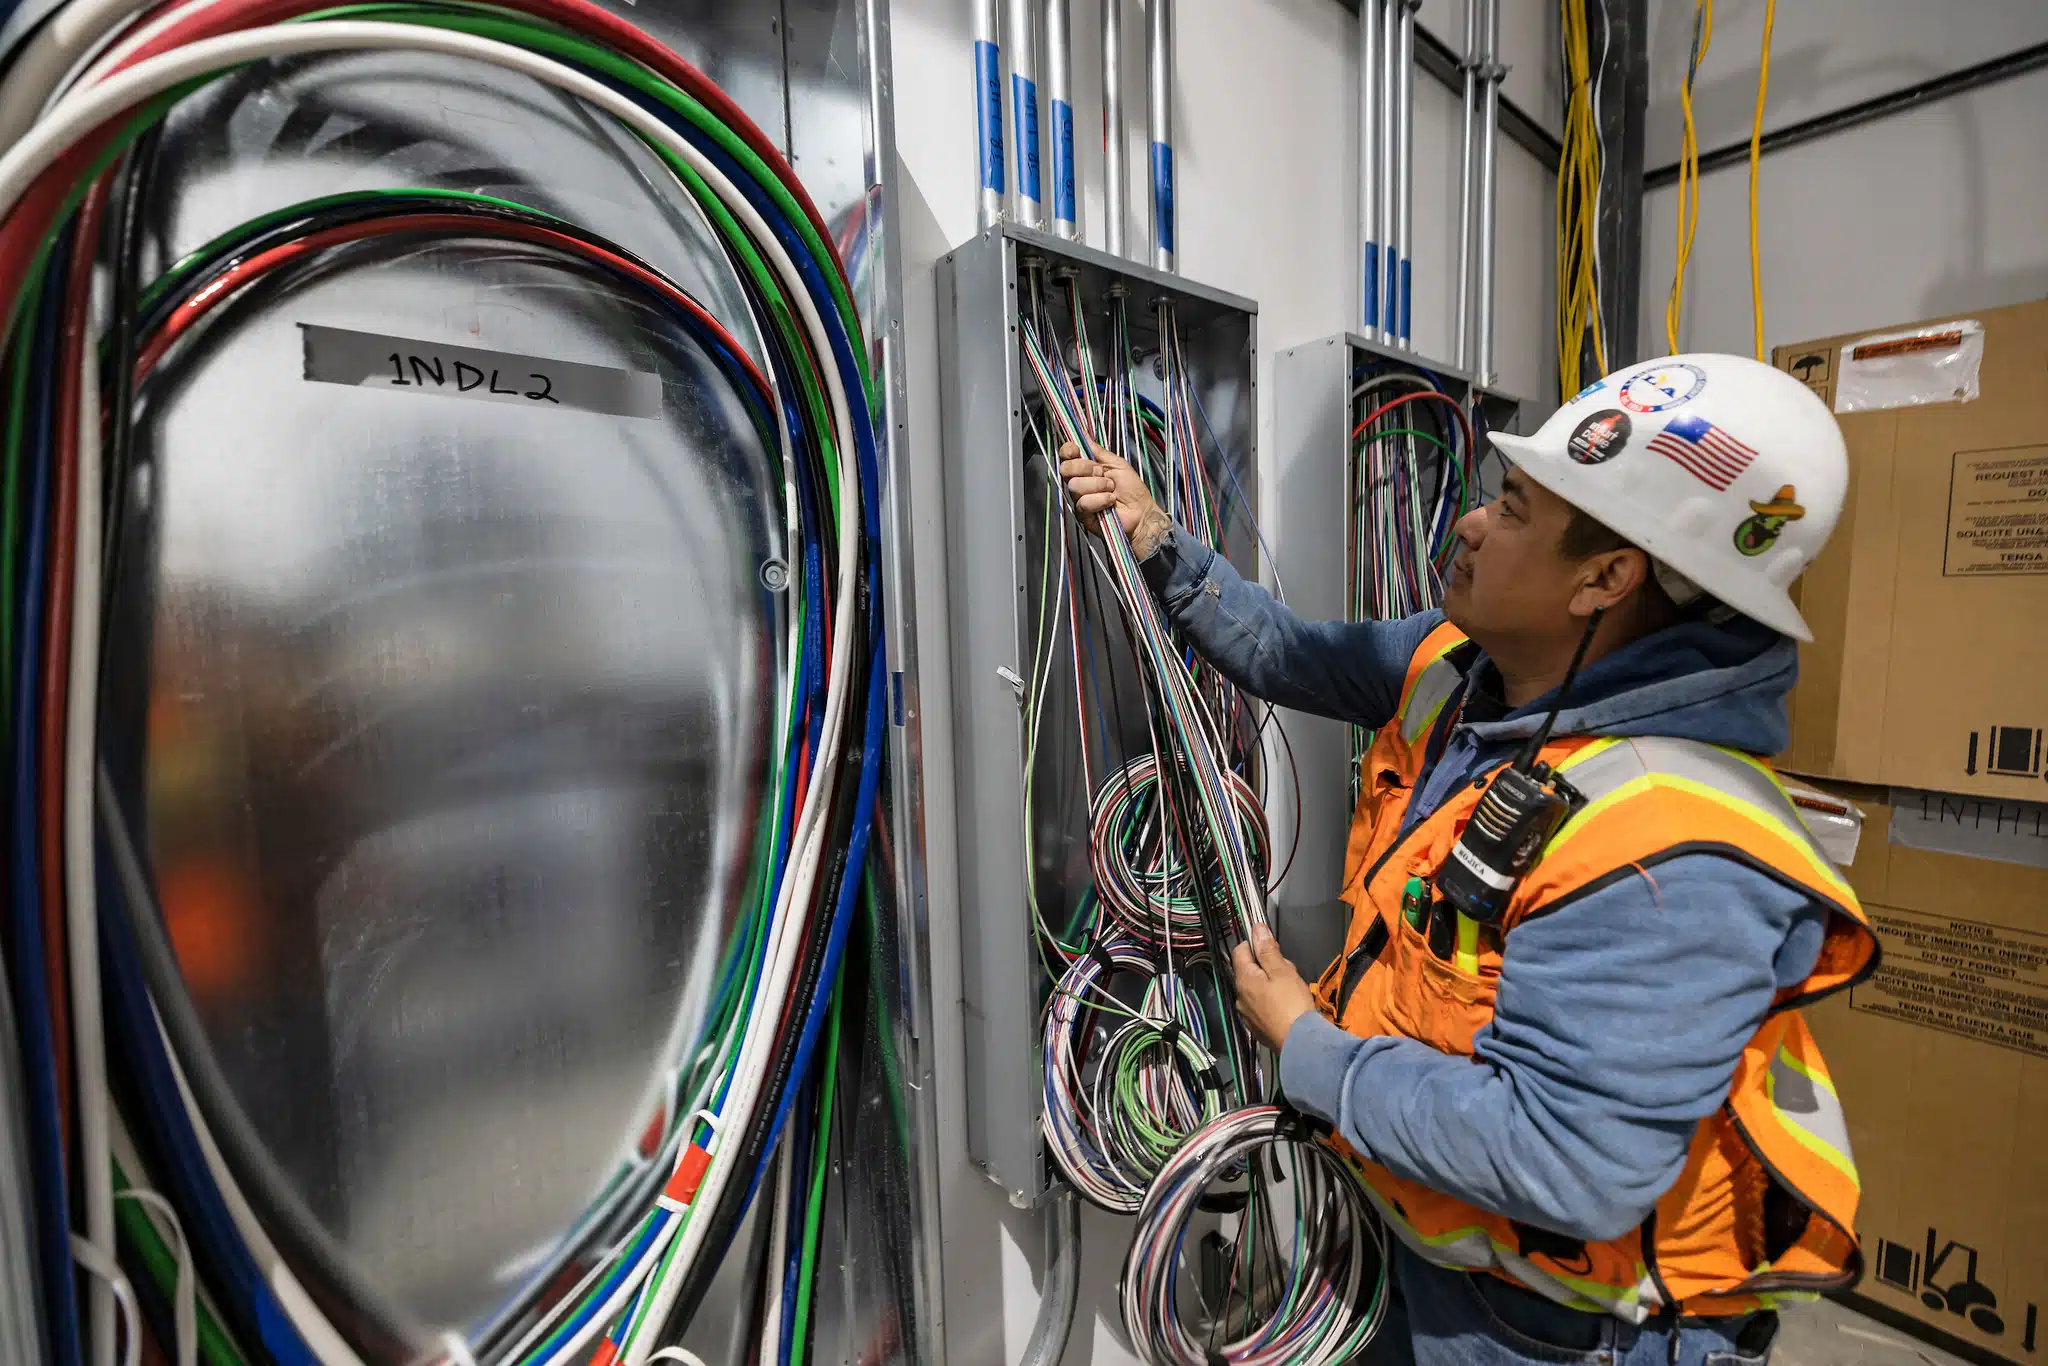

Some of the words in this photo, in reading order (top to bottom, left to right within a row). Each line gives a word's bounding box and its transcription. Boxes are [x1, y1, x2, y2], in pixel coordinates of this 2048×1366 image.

[389, 353, 560, 403] 1NDL2
[1876, 926, 1927, 942] REQUEST
[1931, 936, 1995, 954] IMMEDIATE
[1950, 921, 1993, 936] NOTICE
[1921, 951, 1938, 961] DO
[1941, 955, 1965, 968] NOT
[1969, 961, 2017, 978] FORGET
[1950, 971, 1985, 984] AVISO
